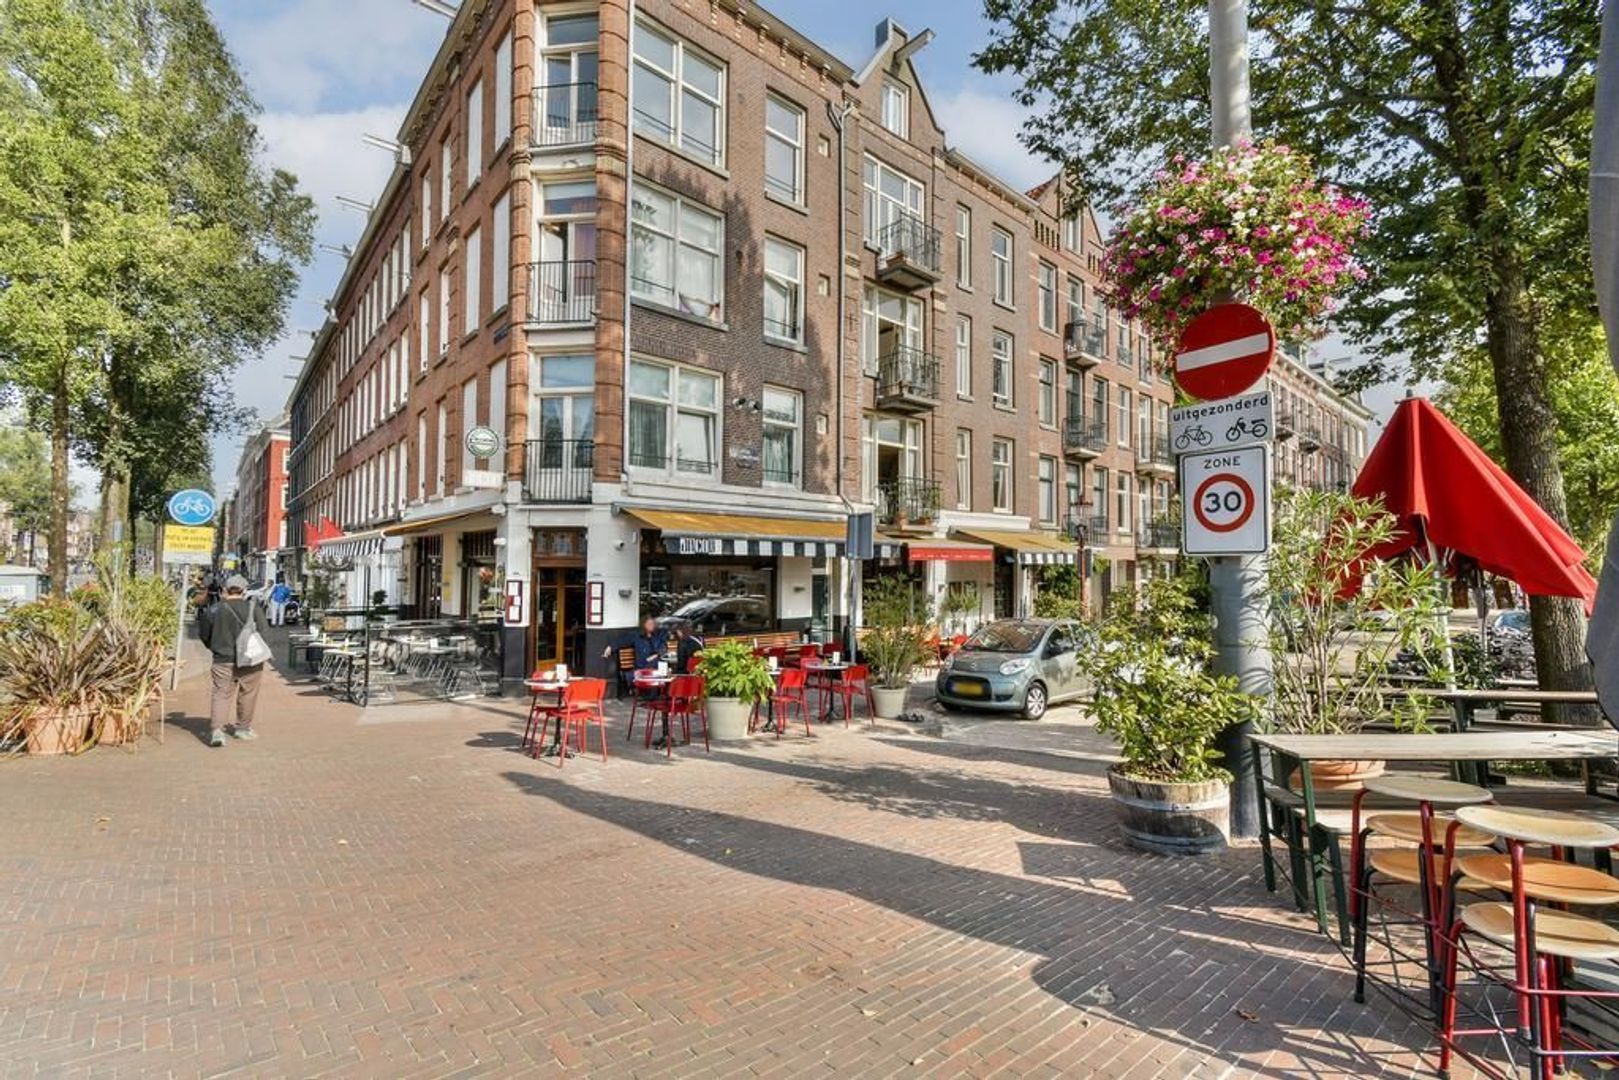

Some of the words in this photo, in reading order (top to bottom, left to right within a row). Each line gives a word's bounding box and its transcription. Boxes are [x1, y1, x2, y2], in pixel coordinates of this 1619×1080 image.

[1173, 394, 1268, 421] uitgezonderd
[1203, 456, 1241, 469] ZONE
[1204, 490, 1242, 514] 30
